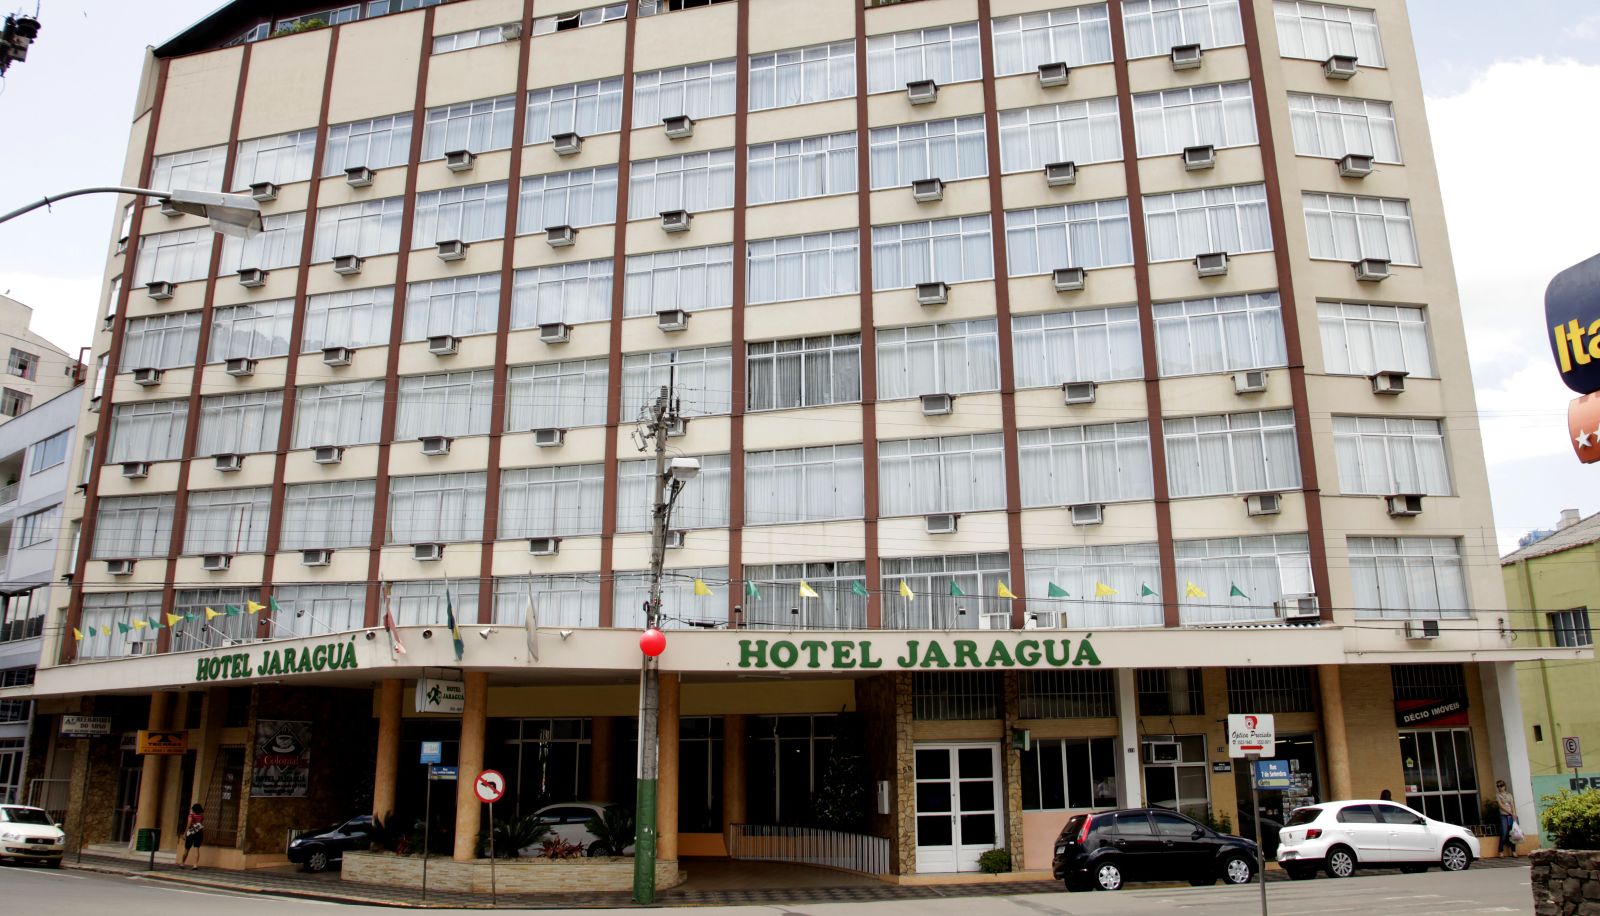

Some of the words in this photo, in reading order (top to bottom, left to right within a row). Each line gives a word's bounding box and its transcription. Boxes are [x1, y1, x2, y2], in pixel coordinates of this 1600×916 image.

[196, 653, 252, 681] HOTEL
[257, 634, 359, 676] JARAGUÁ
[738, 639, 883, 668] HOTEL
[897, 632, 1101, 668] JARAGUÁ
[1431, 702, 1460, 716] IMÓVEIS
[1568, 741, 1575, 750] E
